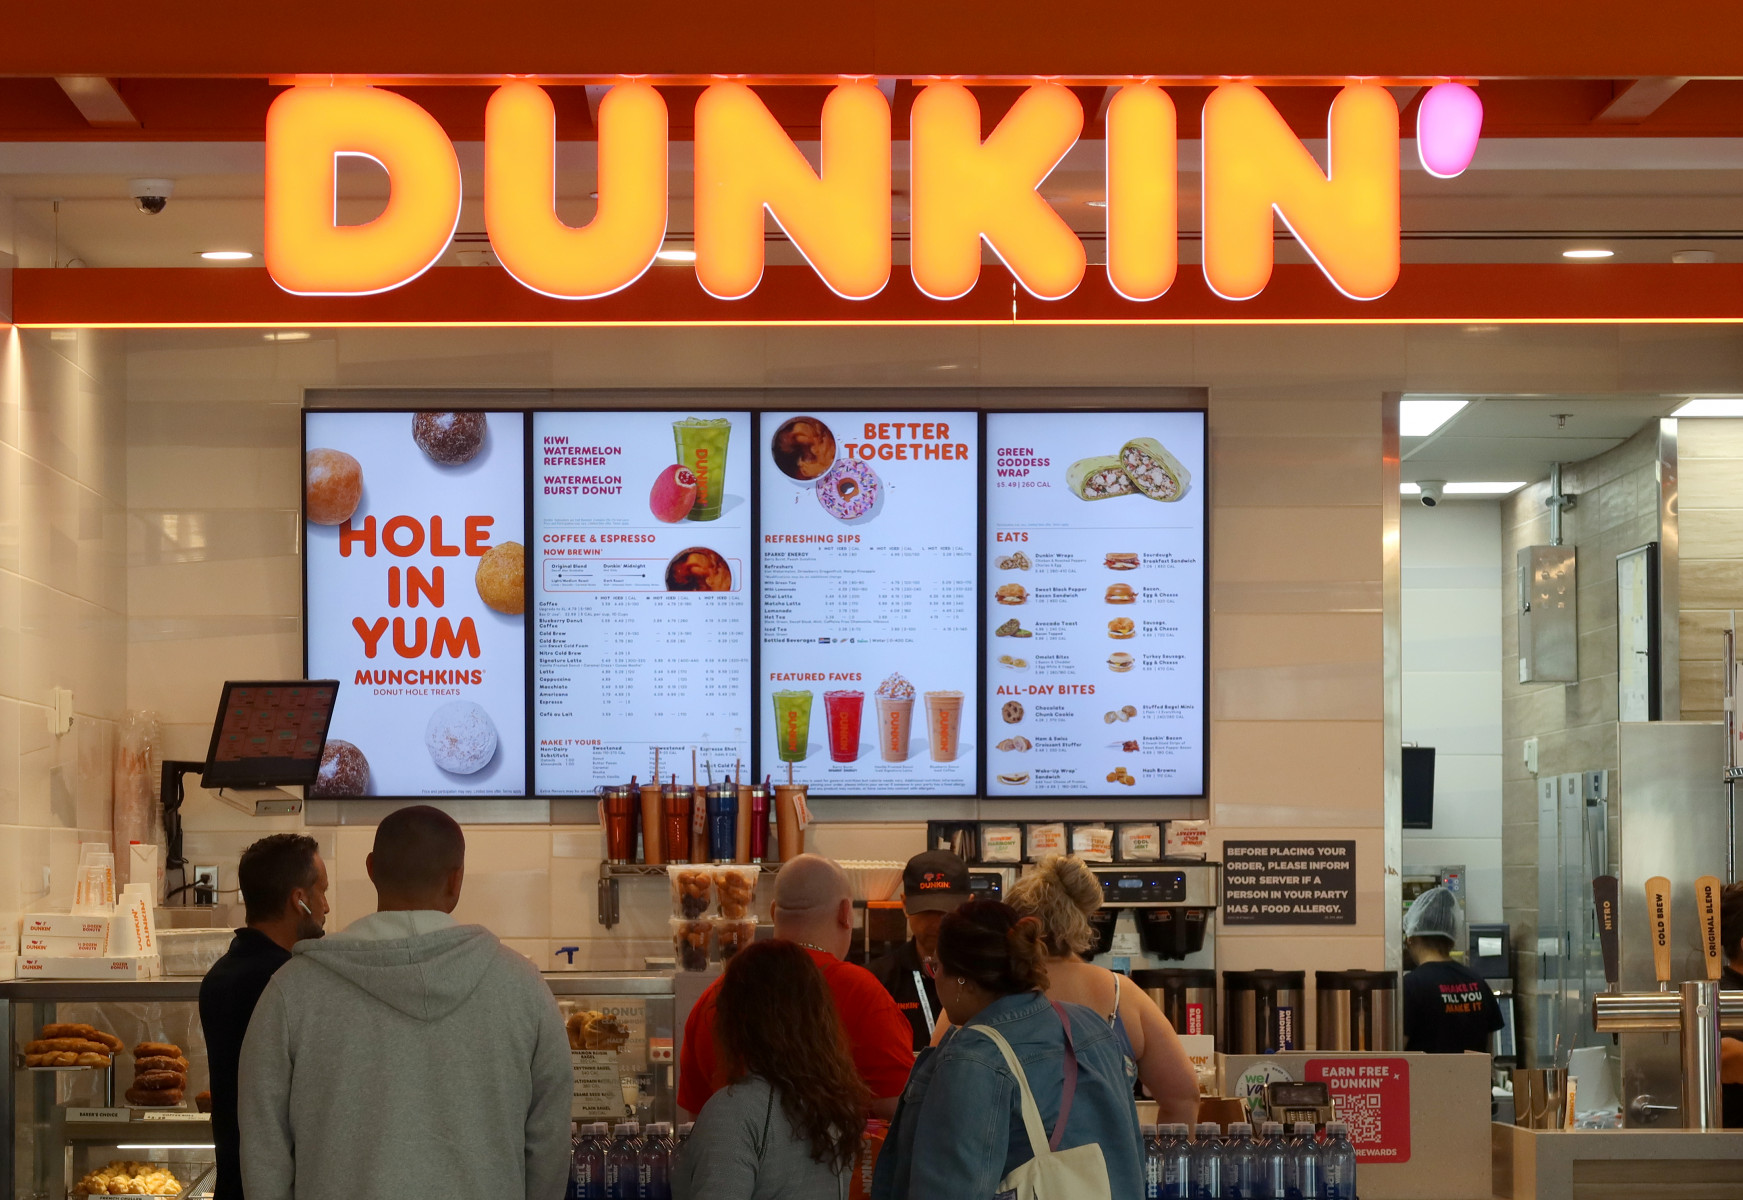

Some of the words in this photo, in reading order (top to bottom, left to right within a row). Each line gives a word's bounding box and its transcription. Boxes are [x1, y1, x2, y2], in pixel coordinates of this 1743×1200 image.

[264, 82, 1483, 301] DUNKIN'
[864, 423, 950, 440] BETTER
[543, 436, 569, 445] KIWI
[543, 446, 622, 455] WATERMELON
[844, 443, 968, 460] TOGETHER
[997, 448, 1034, 456] GREEN
[543, 457, 606, 465] REFRESHER
[997, 458, 1050, 467] GODDESS
[997, 469, 1030, 477] WRAP
[543, 475, 622, 484] WATERMELON
[543, 486, 579, 494] BURST
[582, 486, 623, 494] DONUT
[339, 515, 494, 557] HOLE
[543, 534, 586, 543] COFFEE
[589, 534, 597, 543] &
[600, 534, 656, 543] ESPRESSO
[765, 534, 834, 543] REFRESHING
[837, 534, 861, 543] SIPS
[996, 532, 1029, 542] EATS
[388, 566, 444, 608] IN
[352, 616, 480, 659] YUM
[770, 673, 825, 681] FEATURED
[829, 673, 862, 681] FAVES
[996, 685, 1054, 695] ALL-DAY
[1058, 685, 1095, 694] BITES
[1227, 847, 1268, 856] BEFORE
[1270, 847, 1314, 856] PLACING
[1317, 847, 1346, 856] YOUR
[1227, 862, 1265, 871] ORDER,
[1268, 862, 1307, 870] PLEASE
[1309, 862, 1349, 870] INFORM
[1227, 876, 1256, 884] YOUR
[1259, 876, 1300, 884] SERVER
[1302, 876, 1311, 884] IF
[1313, 876, 1321, 884] A
[1227, 890, 1269, 899] PERSON
[1270, 890, 1281, 899] IN
[1284, 890, 1312, 899] YOUR
[1314, 890, 1348, 899] PARTY
[1704, 885, 1713, 914] BLEND
[1227, 905, 1248, 913] HAS
[1251, 905, 1259, 913] A
[1261, 905, 1290, 913] FOOD
[1292, 905, 1341, 913] ALLERGY.
[1655, 893, 1664, 921] BREW
[1603, 900, 1612, 931] NITRO
[1658, 924, 1666, 946] COLD
[1706, 917, 1717, 958] ORIGINAL
[1438, 983, 1466, 992] SHAKE
[1468, 982, 1478, 991] IT
[1441, 993, 1459, 1003] TILL
[1461, 991, 1482, 1002] YOU
[1468, 1001, 1481, 1012] IT
[1321, 1067, 1355, 1077] EARN
[1359, 1066, 1389, 1076] FREE
[1331, 1079, 1383, 1088] DUNKIN'
